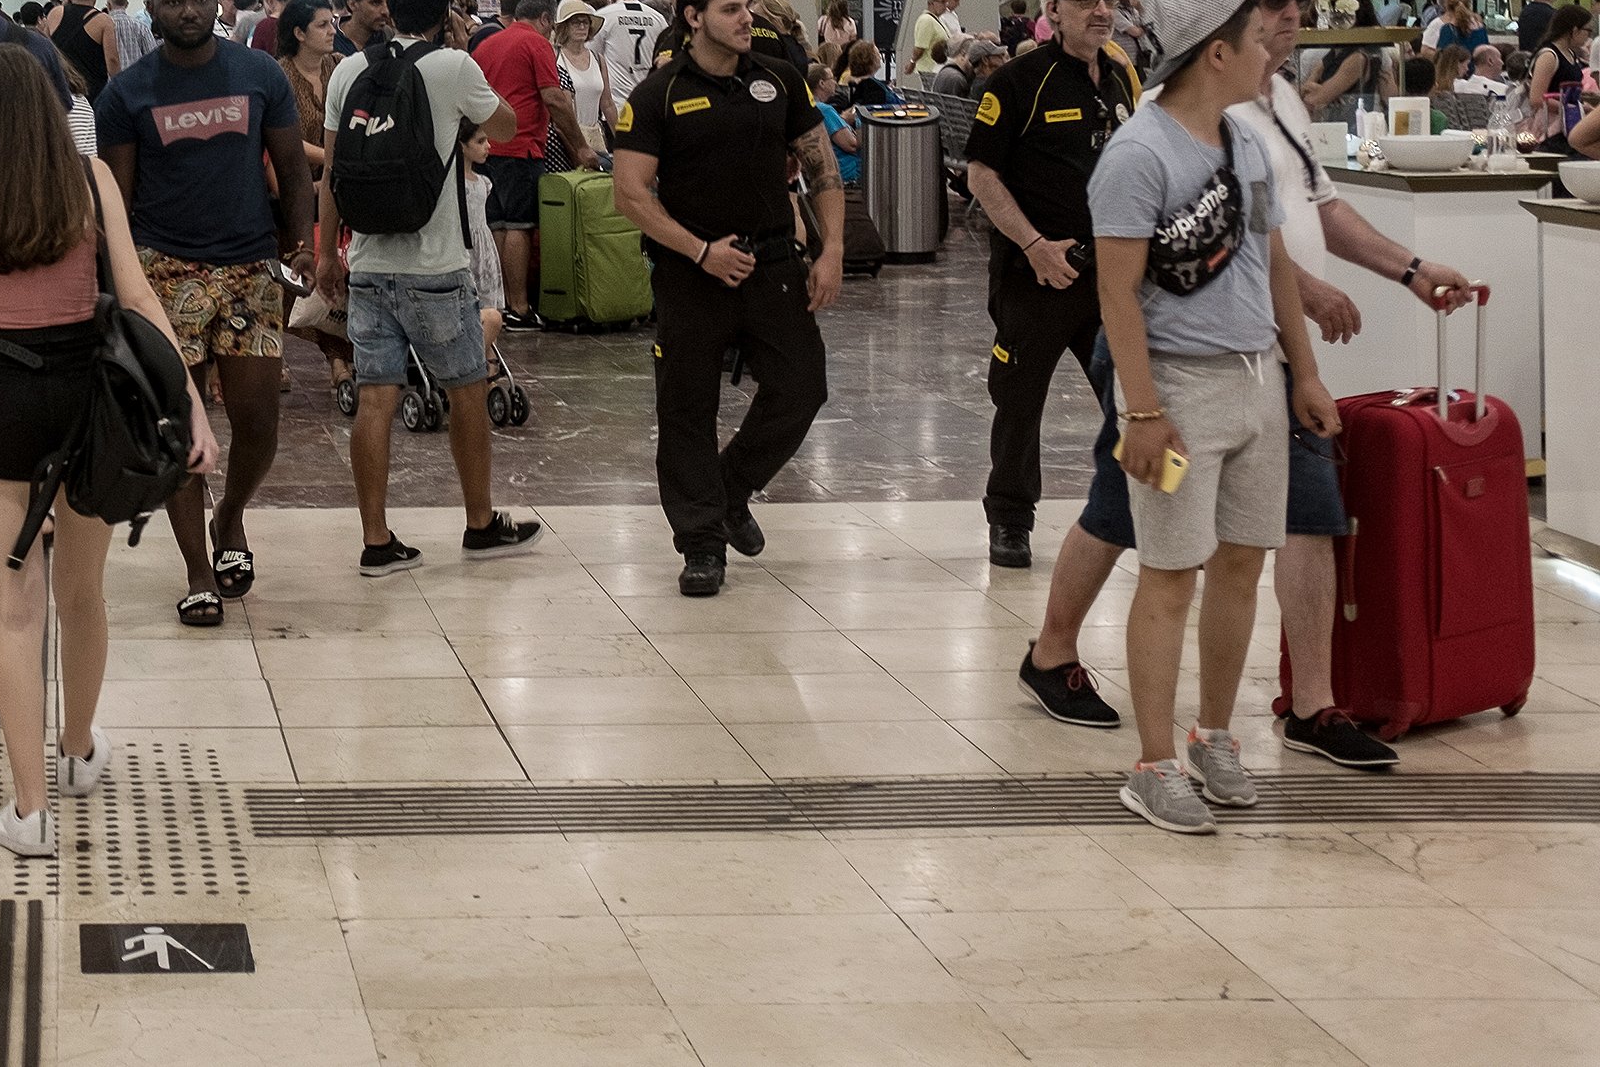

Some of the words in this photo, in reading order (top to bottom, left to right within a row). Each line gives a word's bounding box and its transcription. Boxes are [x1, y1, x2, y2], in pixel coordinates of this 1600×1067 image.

[617, 16, 653, 27] RONALDO
[628, 28, 646, 65] 7
[221, 550, 246, 562] NIKE
